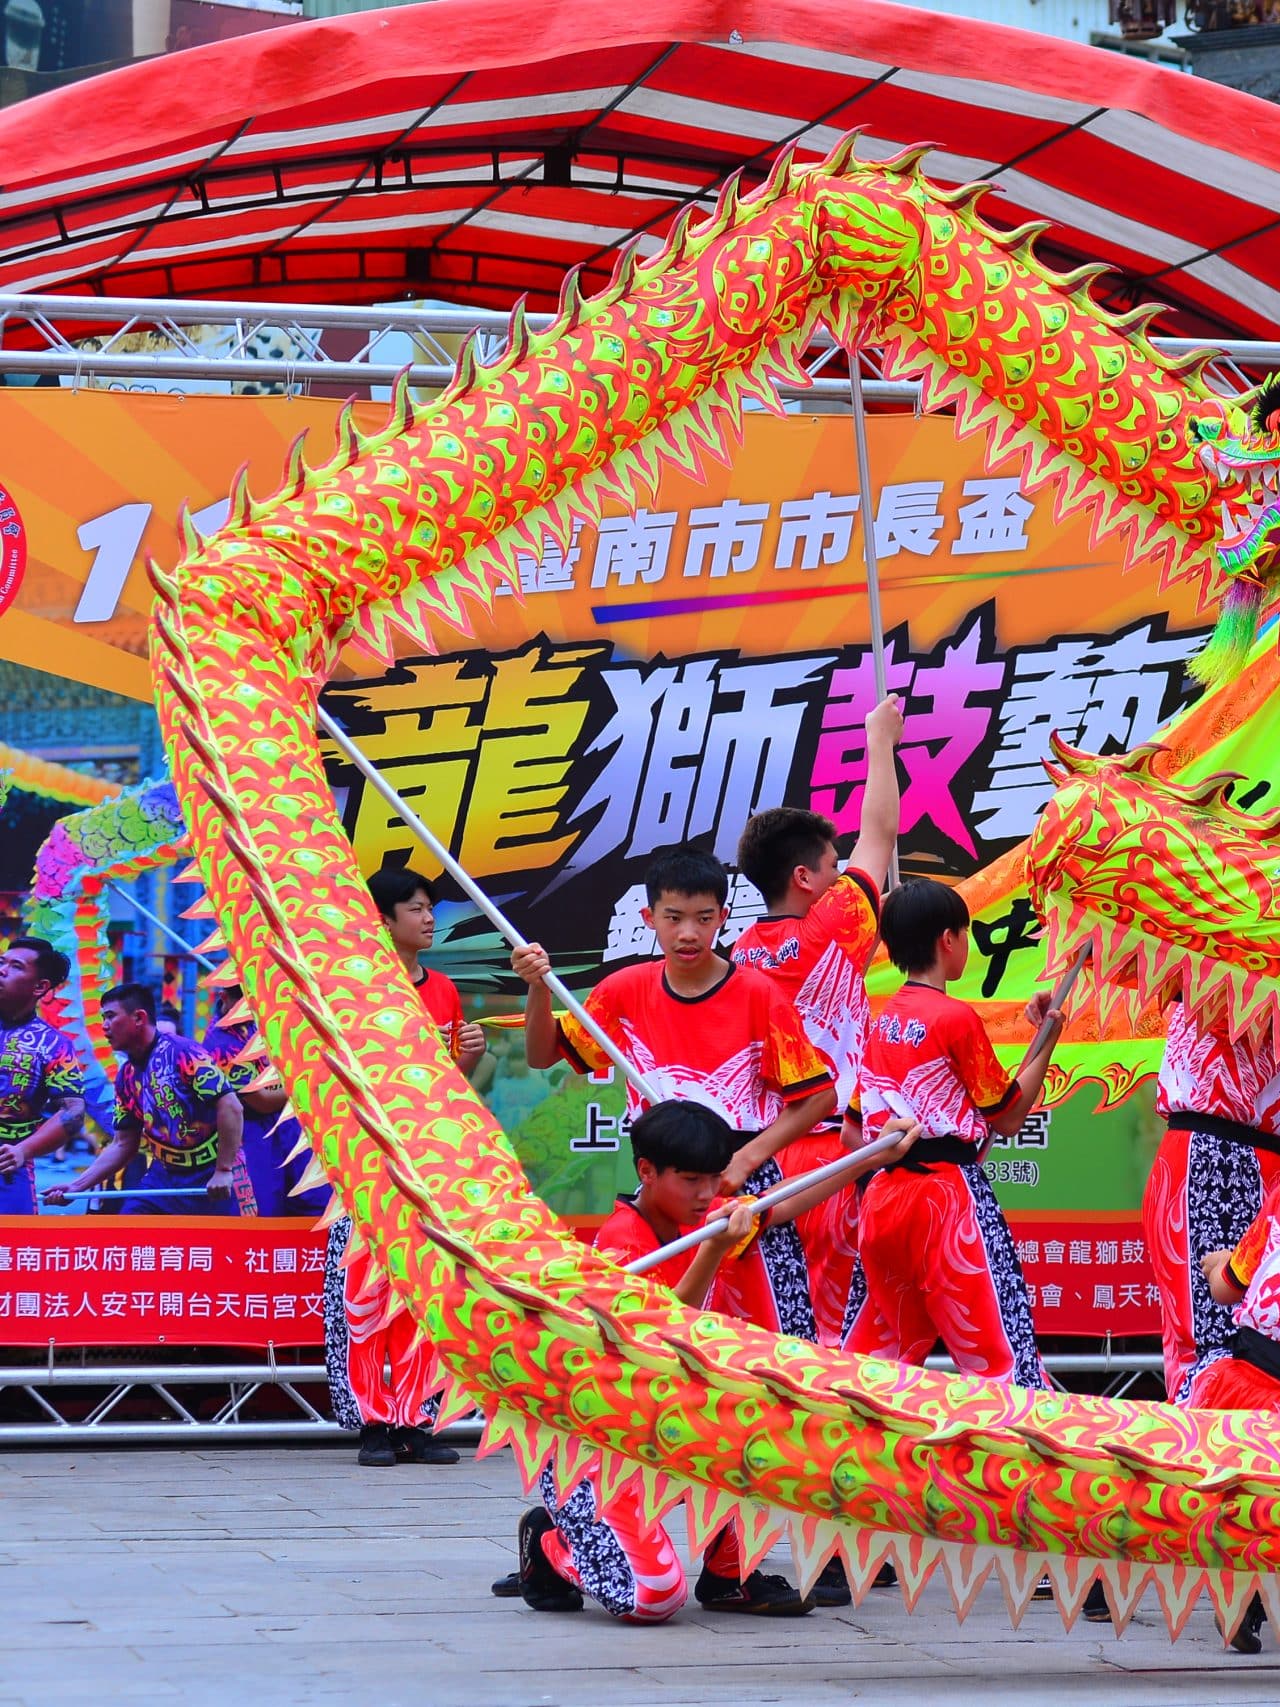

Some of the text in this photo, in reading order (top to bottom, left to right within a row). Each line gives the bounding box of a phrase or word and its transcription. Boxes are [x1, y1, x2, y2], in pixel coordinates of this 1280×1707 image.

[1016, 1240, 1152, 1265] 總會龍獅鼓
